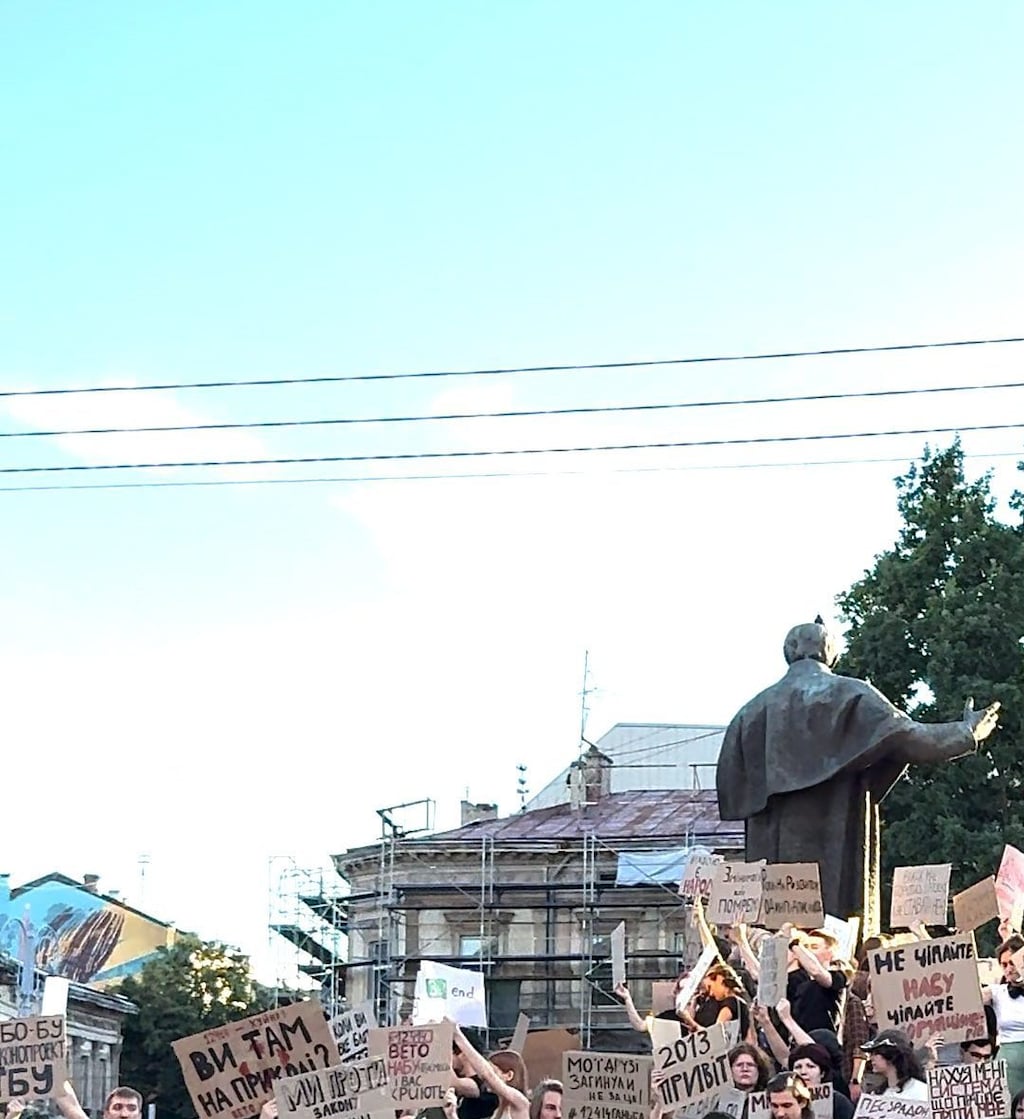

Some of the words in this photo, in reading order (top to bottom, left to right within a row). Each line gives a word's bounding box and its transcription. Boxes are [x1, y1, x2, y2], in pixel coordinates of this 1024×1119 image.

[874, 950, 906, 975] НЕ
[915, 941, 974, 968] ЧІПАЙТЕ
[903, 973, 955, 1001] НАБУ
[887, 996, 954, 1026] ЧІПАЙТЕ
[189, 1043, 237, 1081] ВИ
[242, 1016, 312, 1060] ТАМ
[389, 1043, 430, 1059] ВЕТО
[659, 1031, 710, 1069] 2013
[281, 1074, 324, 1111] МИ
[329, 1058, 388, 1098] ПРОТИ
[401, 1075, 422, 1087] ВАС
[569, 1074, 635, 1091] ЗАГИНУЛИ
[658, 1055, 728, 1105] ПРИВІТ
[929, 1066, 972, 1087] НАХУЯ
[975, 1060, 1005, 1081] МЕНІ
[931, 1077, 1004, 1099] СИСТЕМА
[197, 1086, 233, 1117] НА
[589, 1090, 603, 1101] НЕ
